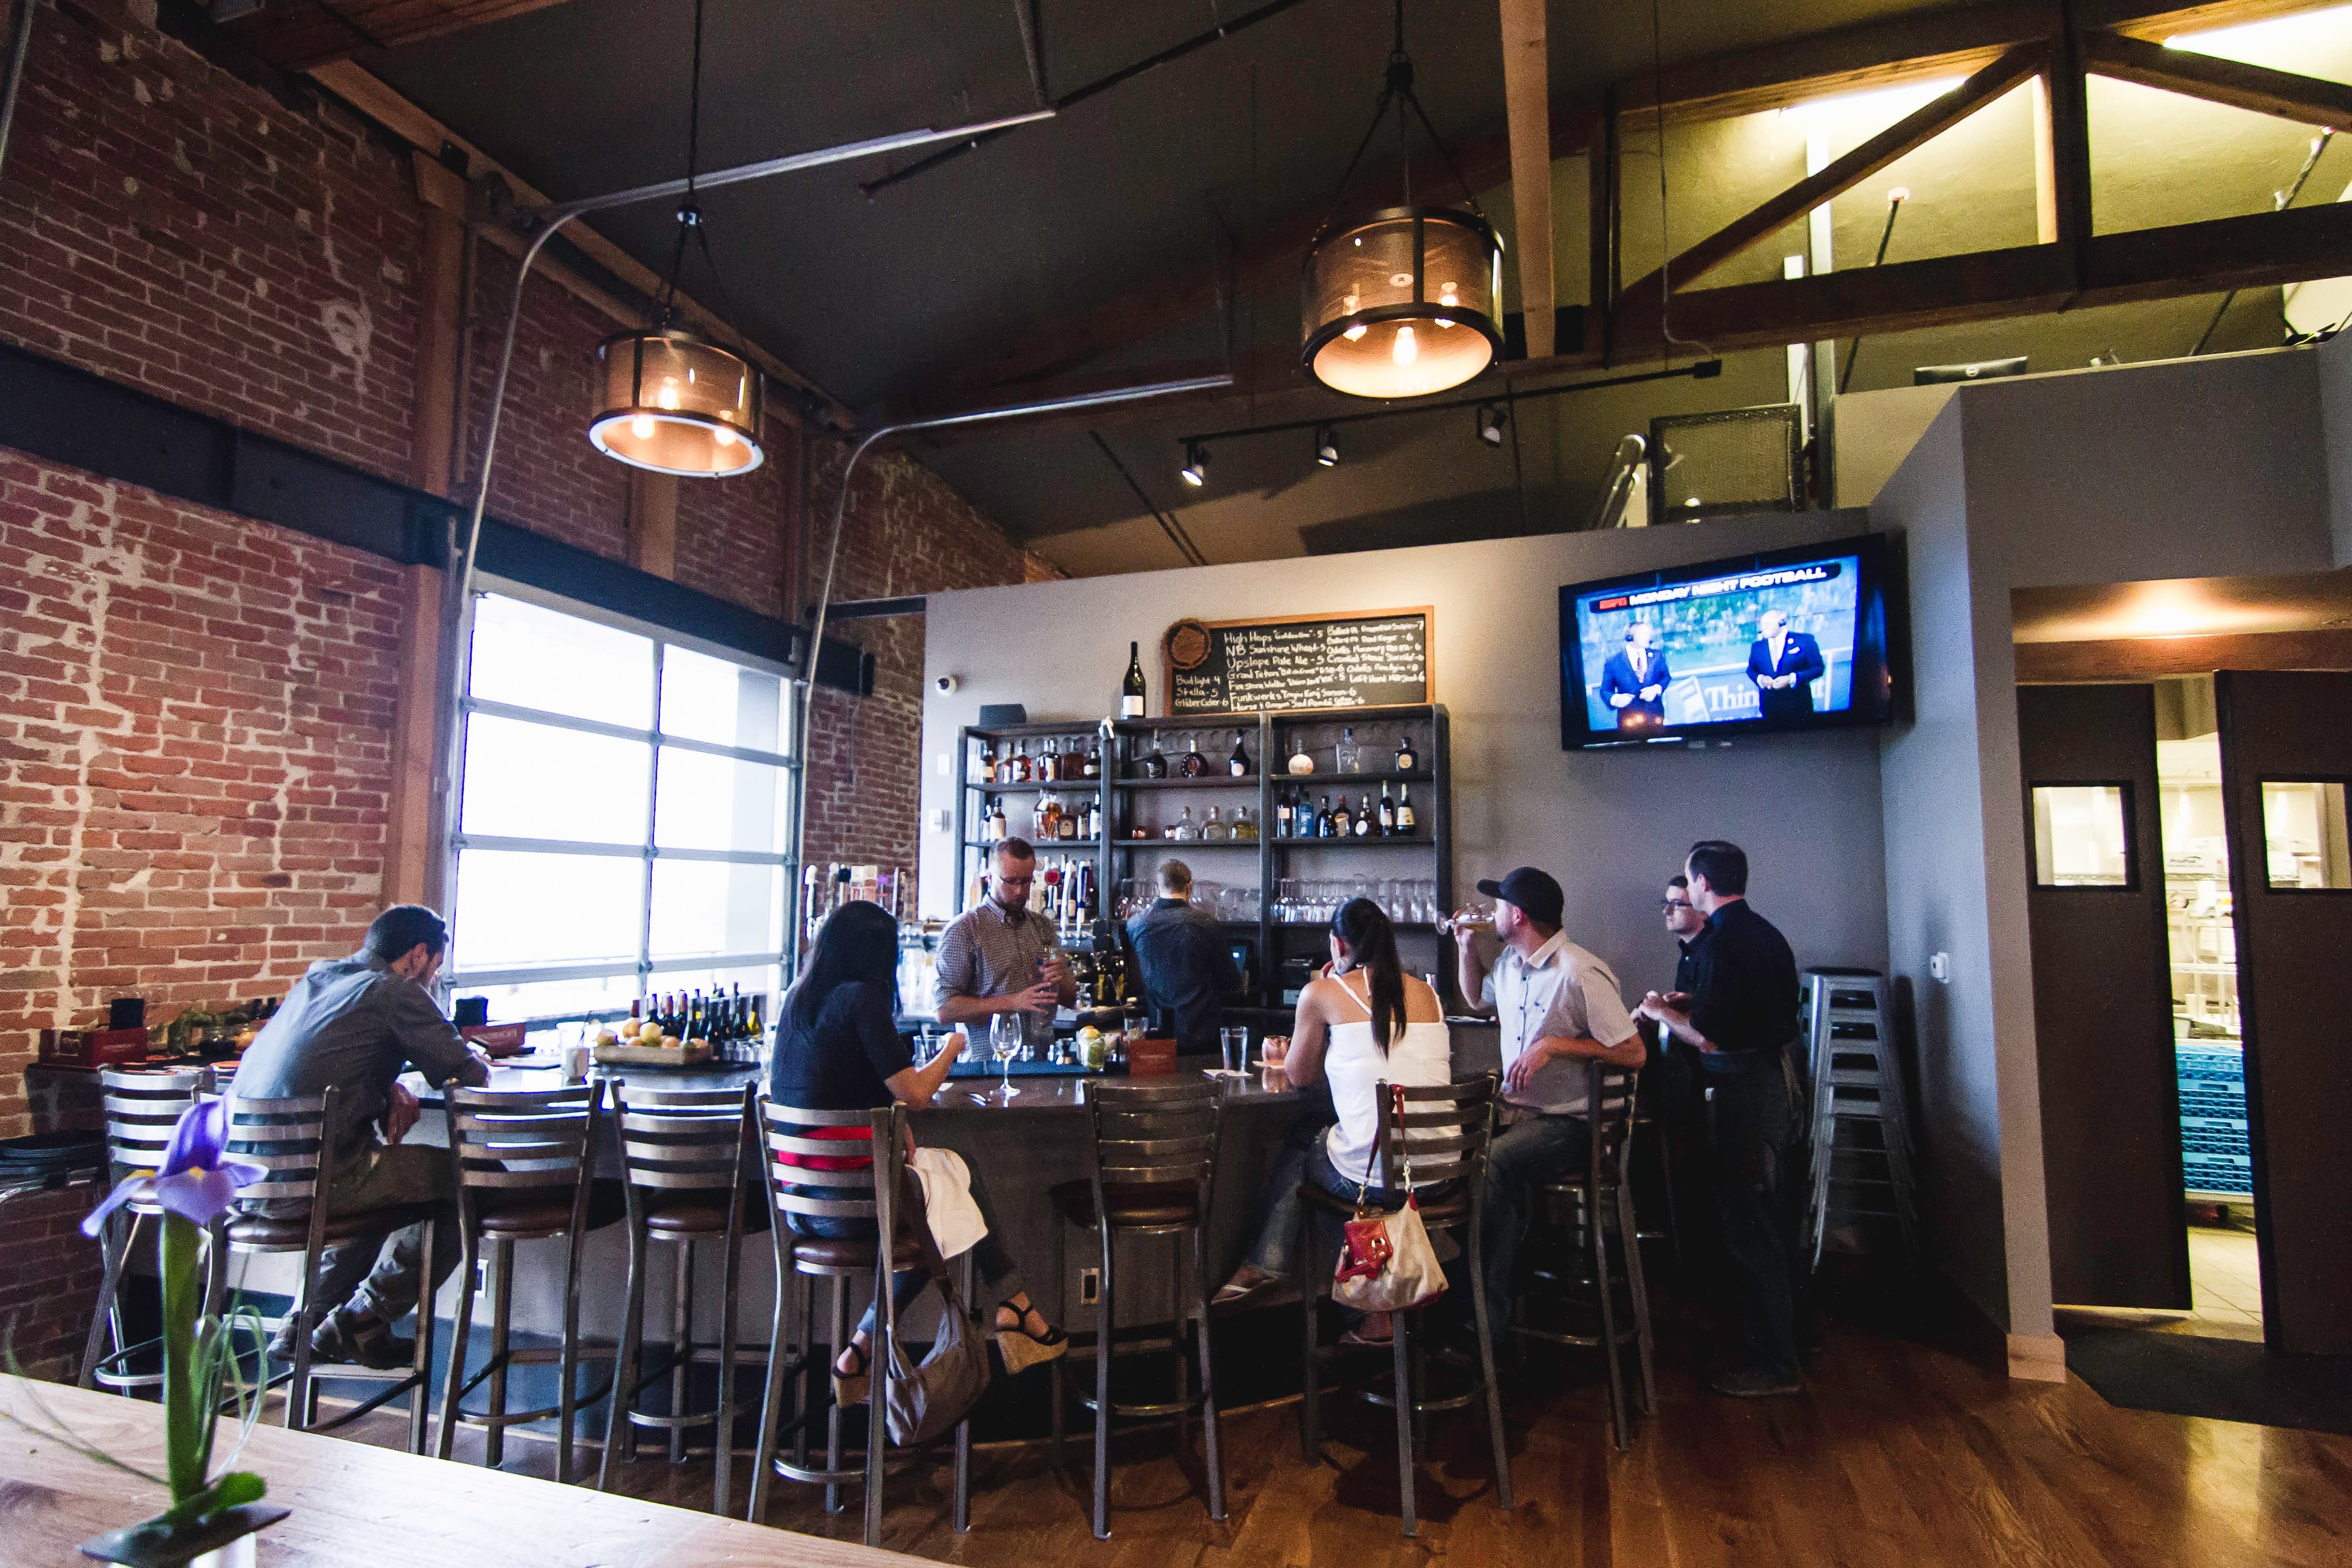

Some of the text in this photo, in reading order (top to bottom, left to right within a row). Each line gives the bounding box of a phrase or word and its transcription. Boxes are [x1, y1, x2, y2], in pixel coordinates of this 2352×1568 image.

[1599, 567, 1826, 609] ESPN MONDAY NIGHT FOOTBALL
[1224, 632, 1248, 643] High
[1250, 631, 1272, 647] Hops
[1226, 644, 1246, 657] NB
[1227, 656, 1270, 671] Upslope
[1272, 655, 1292, 666] Pale
[1176, 687, 1205, 696] Stella
[1229, 690, 1282, 703] Funkwerks
